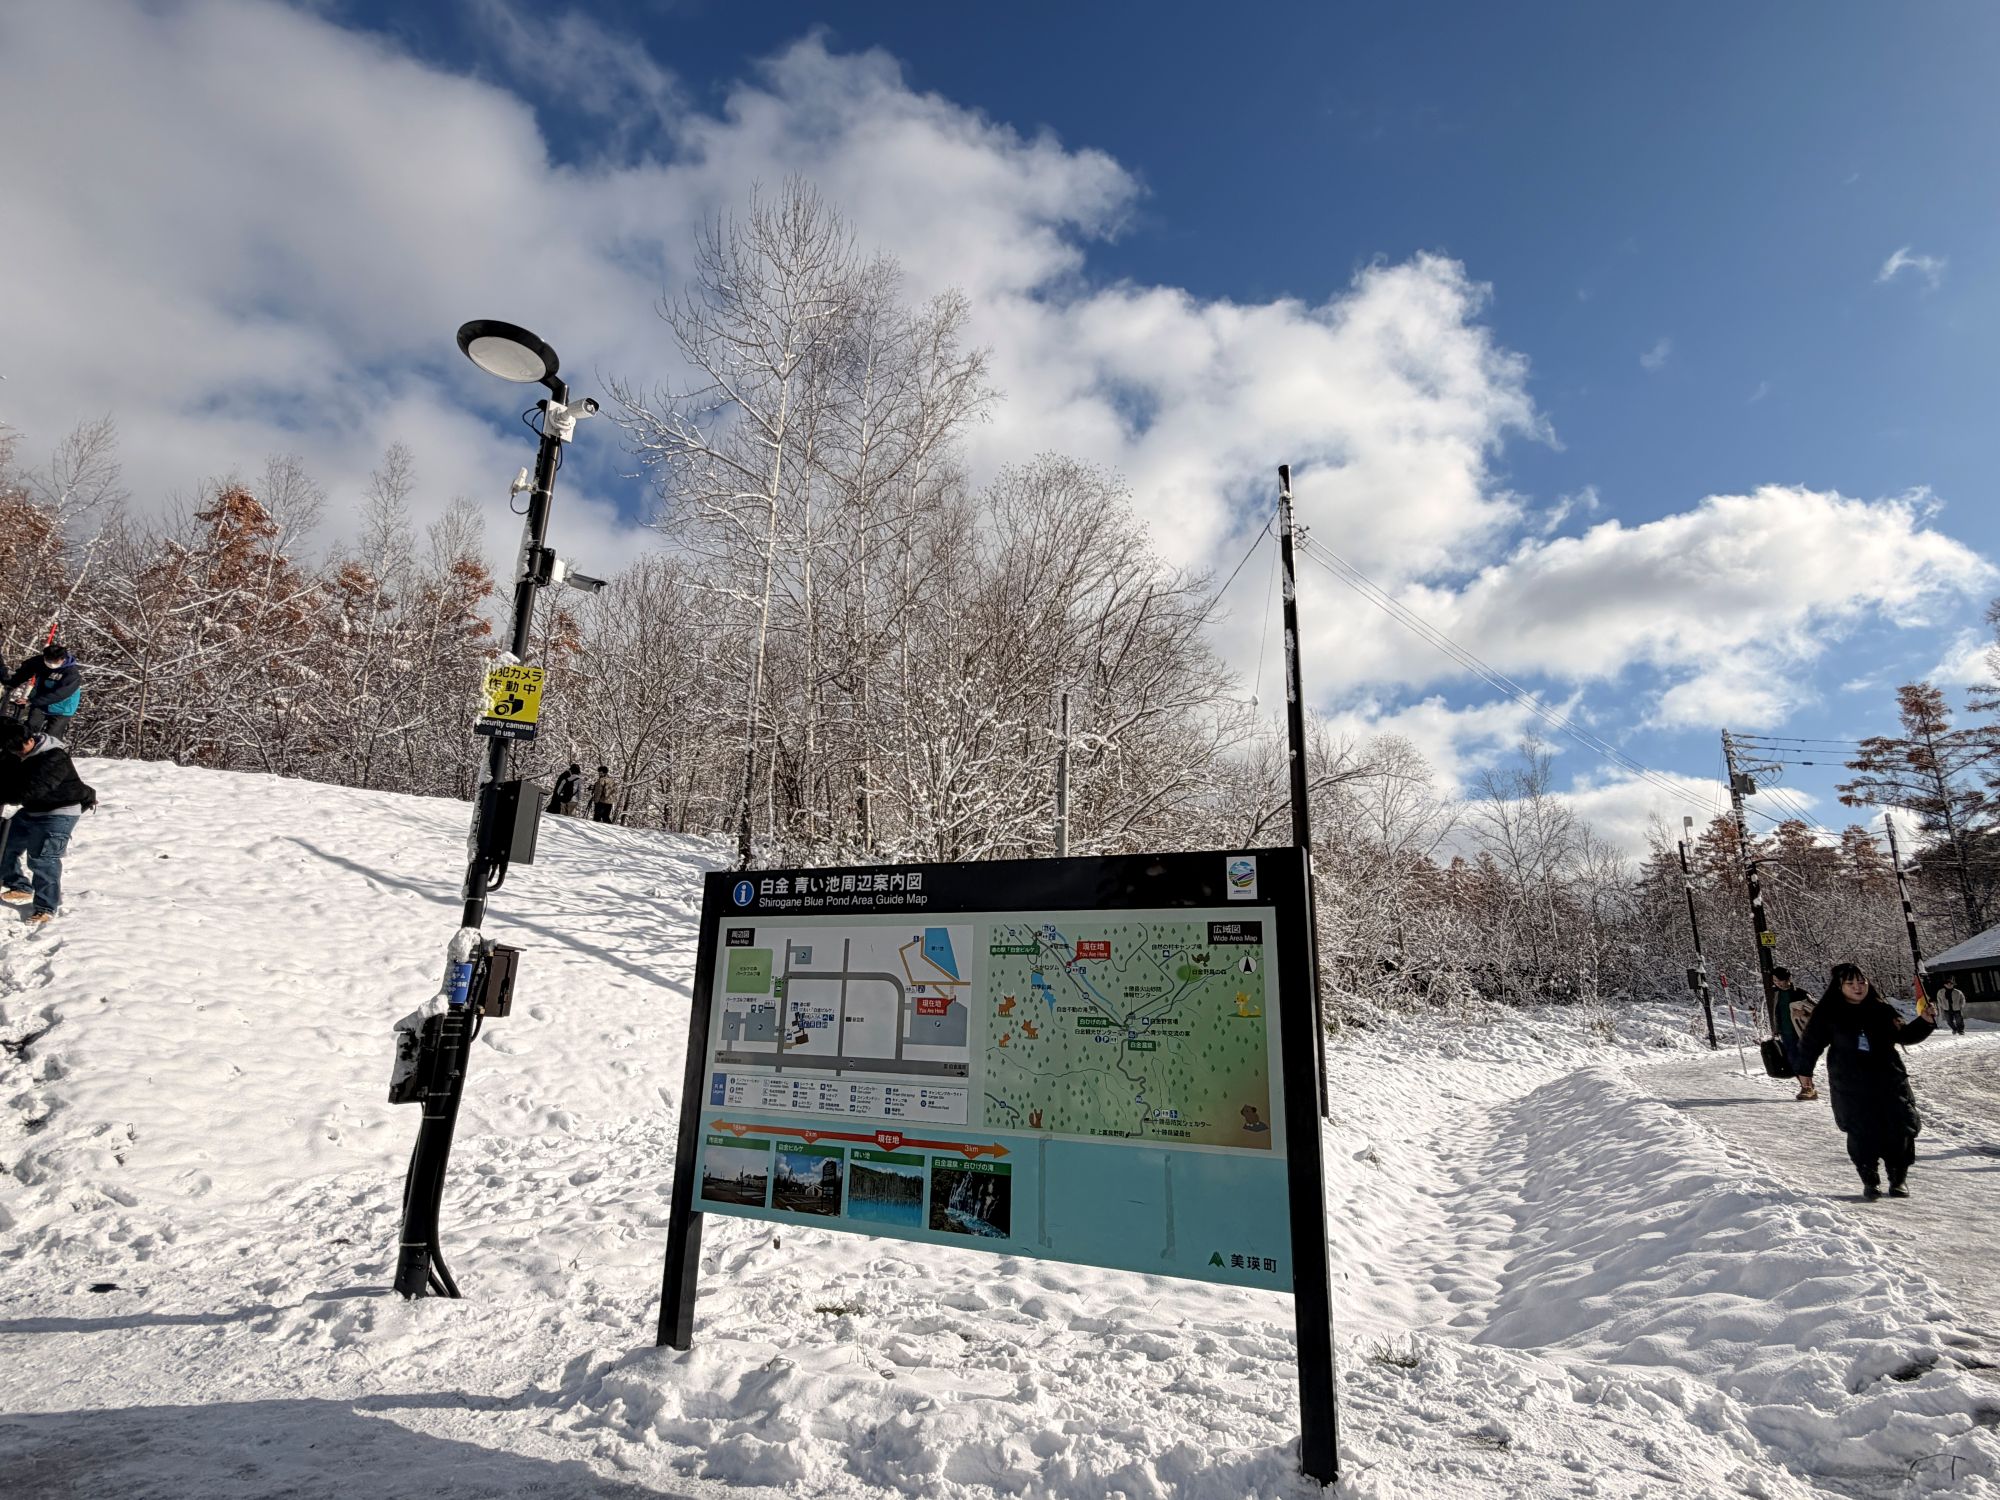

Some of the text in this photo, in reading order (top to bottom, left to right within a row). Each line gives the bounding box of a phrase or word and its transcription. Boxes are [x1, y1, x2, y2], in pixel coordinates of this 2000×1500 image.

[489, 666, 542, 683] 犯カメラ
[480, 718, 534, 731] ecurity cameras
[503, 730, 516, 738] use
[760, 872, 923, 895] 白金 青い池周辺案内図
[758, 893, 928, 909] Shirogane Blue Pond Area Guide Map
[1213, 924, 1241, 934] 広域図
[1212, 934, 1258, 943] Wide Area Map
[1082, 942, 1105, 950] 現在地
[878, 1134, 900, 1144] 現在地
[778, 1144, 804, 1152] 白金ビルケ
[964, 1144, 979, 1152] 3km
[853, 1150, 871, 1160] 青い池
[934, 1159, 994, 1171] 白金温泉・白ひげの滝
[1231, 1253, 1277, 1273] 美瑛町
